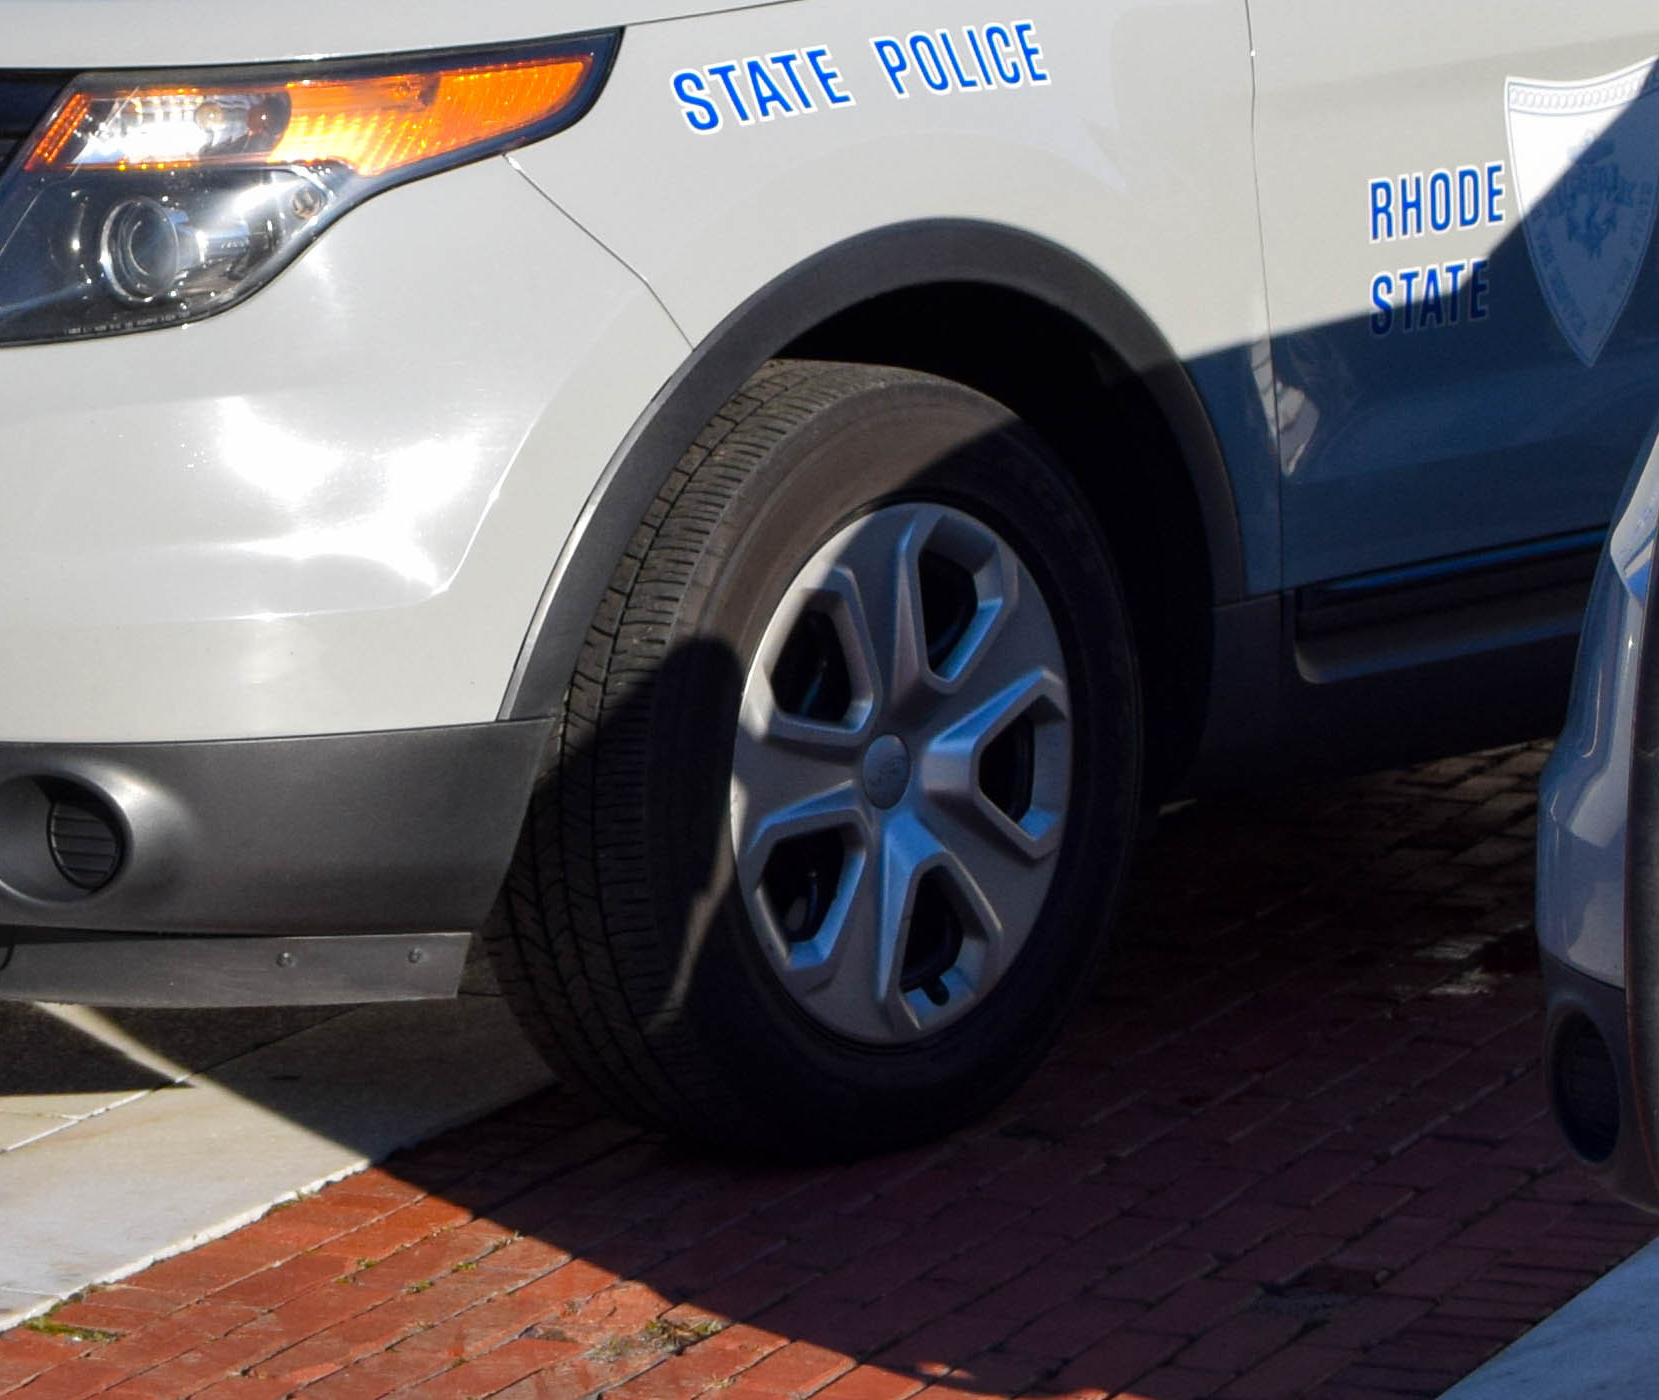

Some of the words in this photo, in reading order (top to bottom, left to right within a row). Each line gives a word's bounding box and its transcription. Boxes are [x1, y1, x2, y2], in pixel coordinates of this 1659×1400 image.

[670, 44, 855, 135] STATE
[869, 19, 1051, 99] POLICE
[1368, 160, 1507, 245] RHODE
[1368, 256, 1492, 338] STATE
